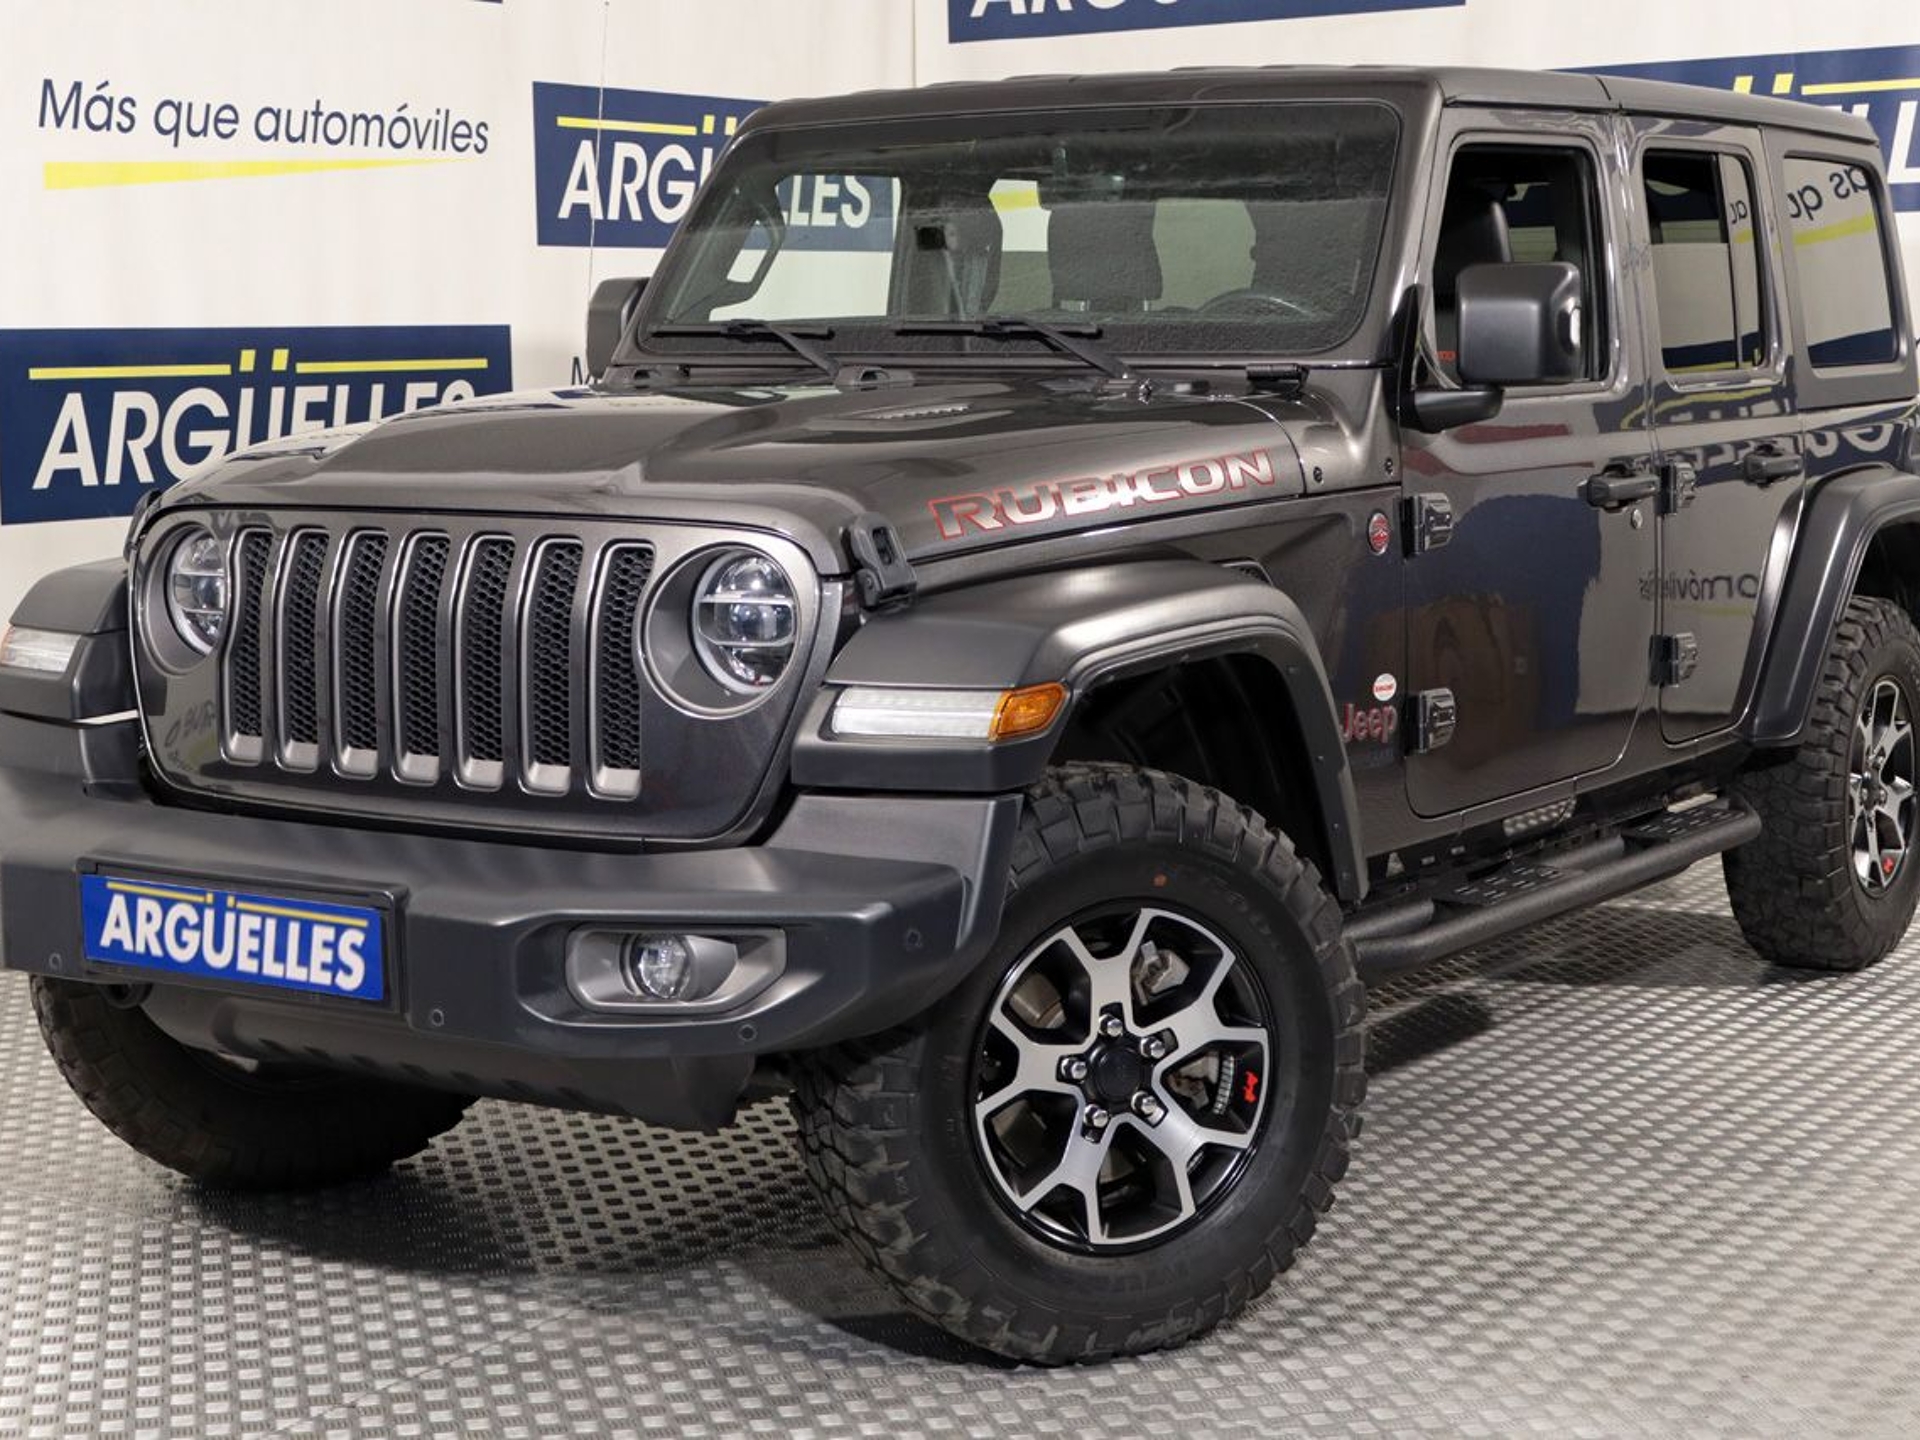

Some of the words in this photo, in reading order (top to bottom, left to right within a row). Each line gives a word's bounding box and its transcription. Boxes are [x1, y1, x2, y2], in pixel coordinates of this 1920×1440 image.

[38, 78, 137, 134] Más
[153, 98, 240, 148] que
[254, 99, 489, 155] automóviles
[931, 449, 1275, 538] RUBICON
[1343, 703, 1398, 744] Jeep
[100, 893, 366, 992] ARGÜELLES
